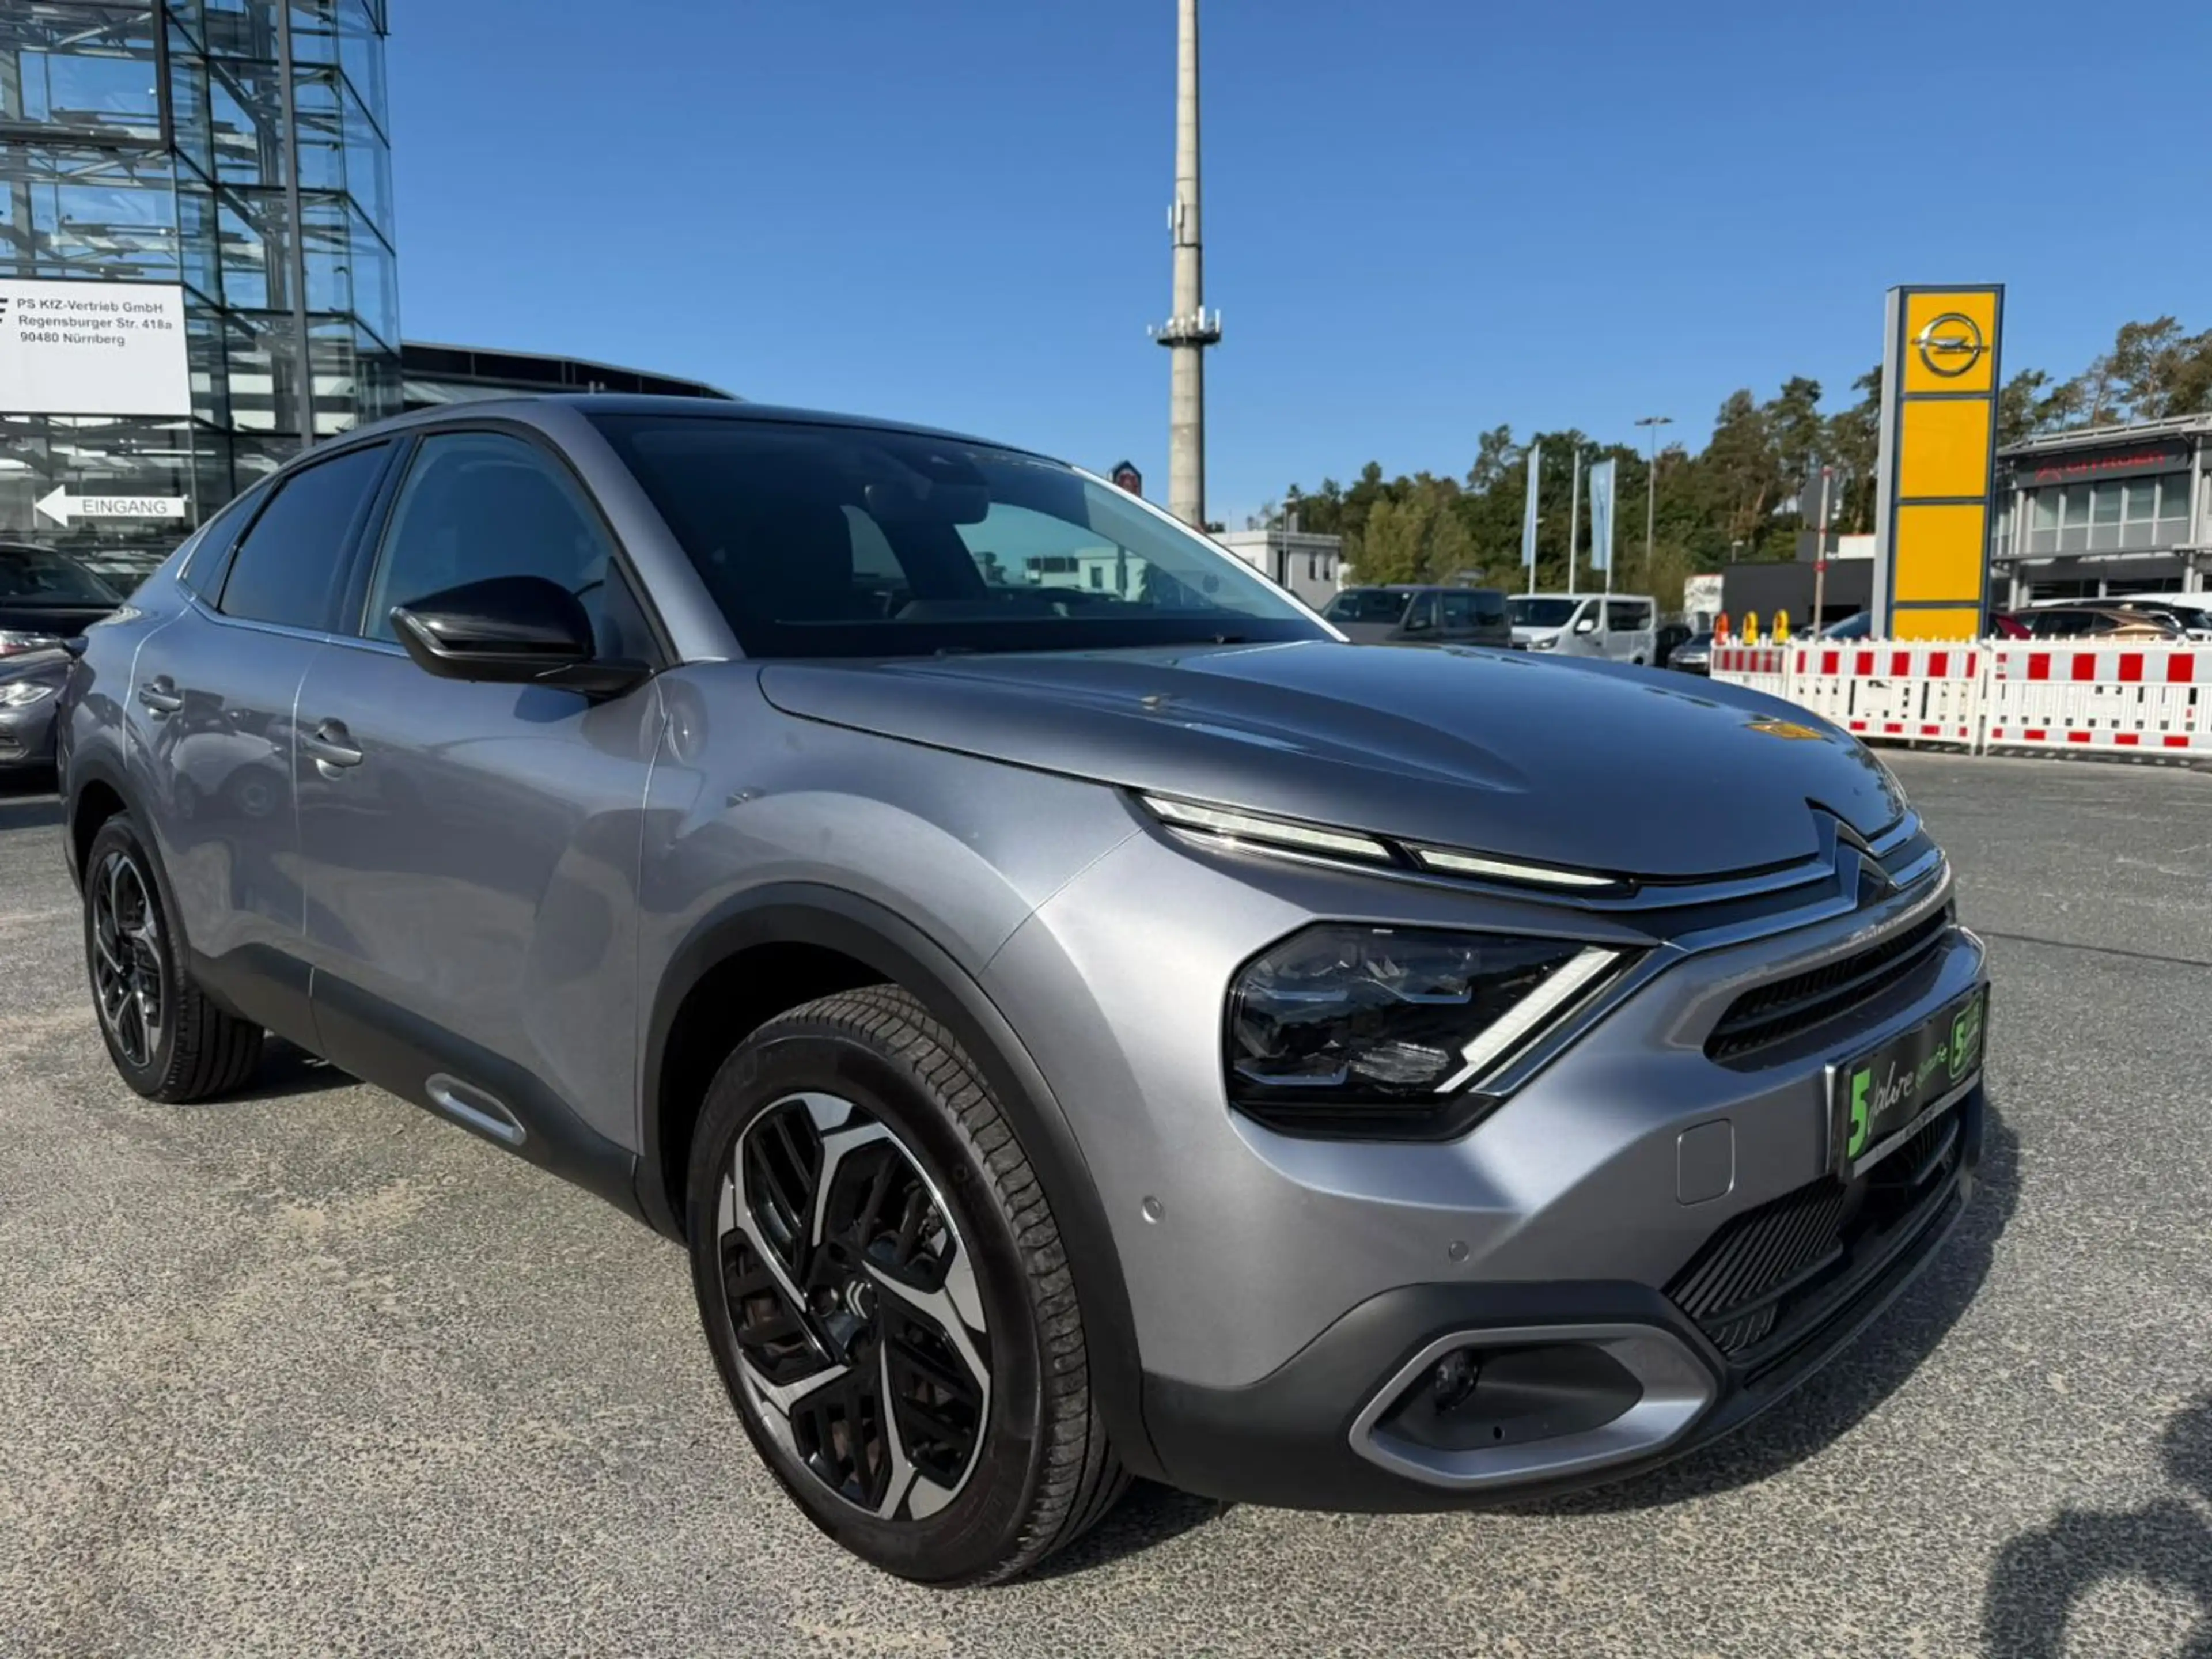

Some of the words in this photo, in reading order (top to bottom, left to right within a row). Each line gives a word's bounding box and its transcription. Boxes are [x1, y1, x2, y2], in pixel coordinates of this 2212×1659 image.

[17, 298, 36, 309] PS
[123, 301, 163, 313] GmbH
[19, 315, 112, 330] Regensburger
[116, 317, 139, 328] Str.
[142, 319, 172, 329] 418a
[20, 332, 59, 342] 90480
[63, 332, 125, 347] Nürnberg
[82, 499, 167, 514] EINGANG
[1849, 1067, 1871, 1157] 5
